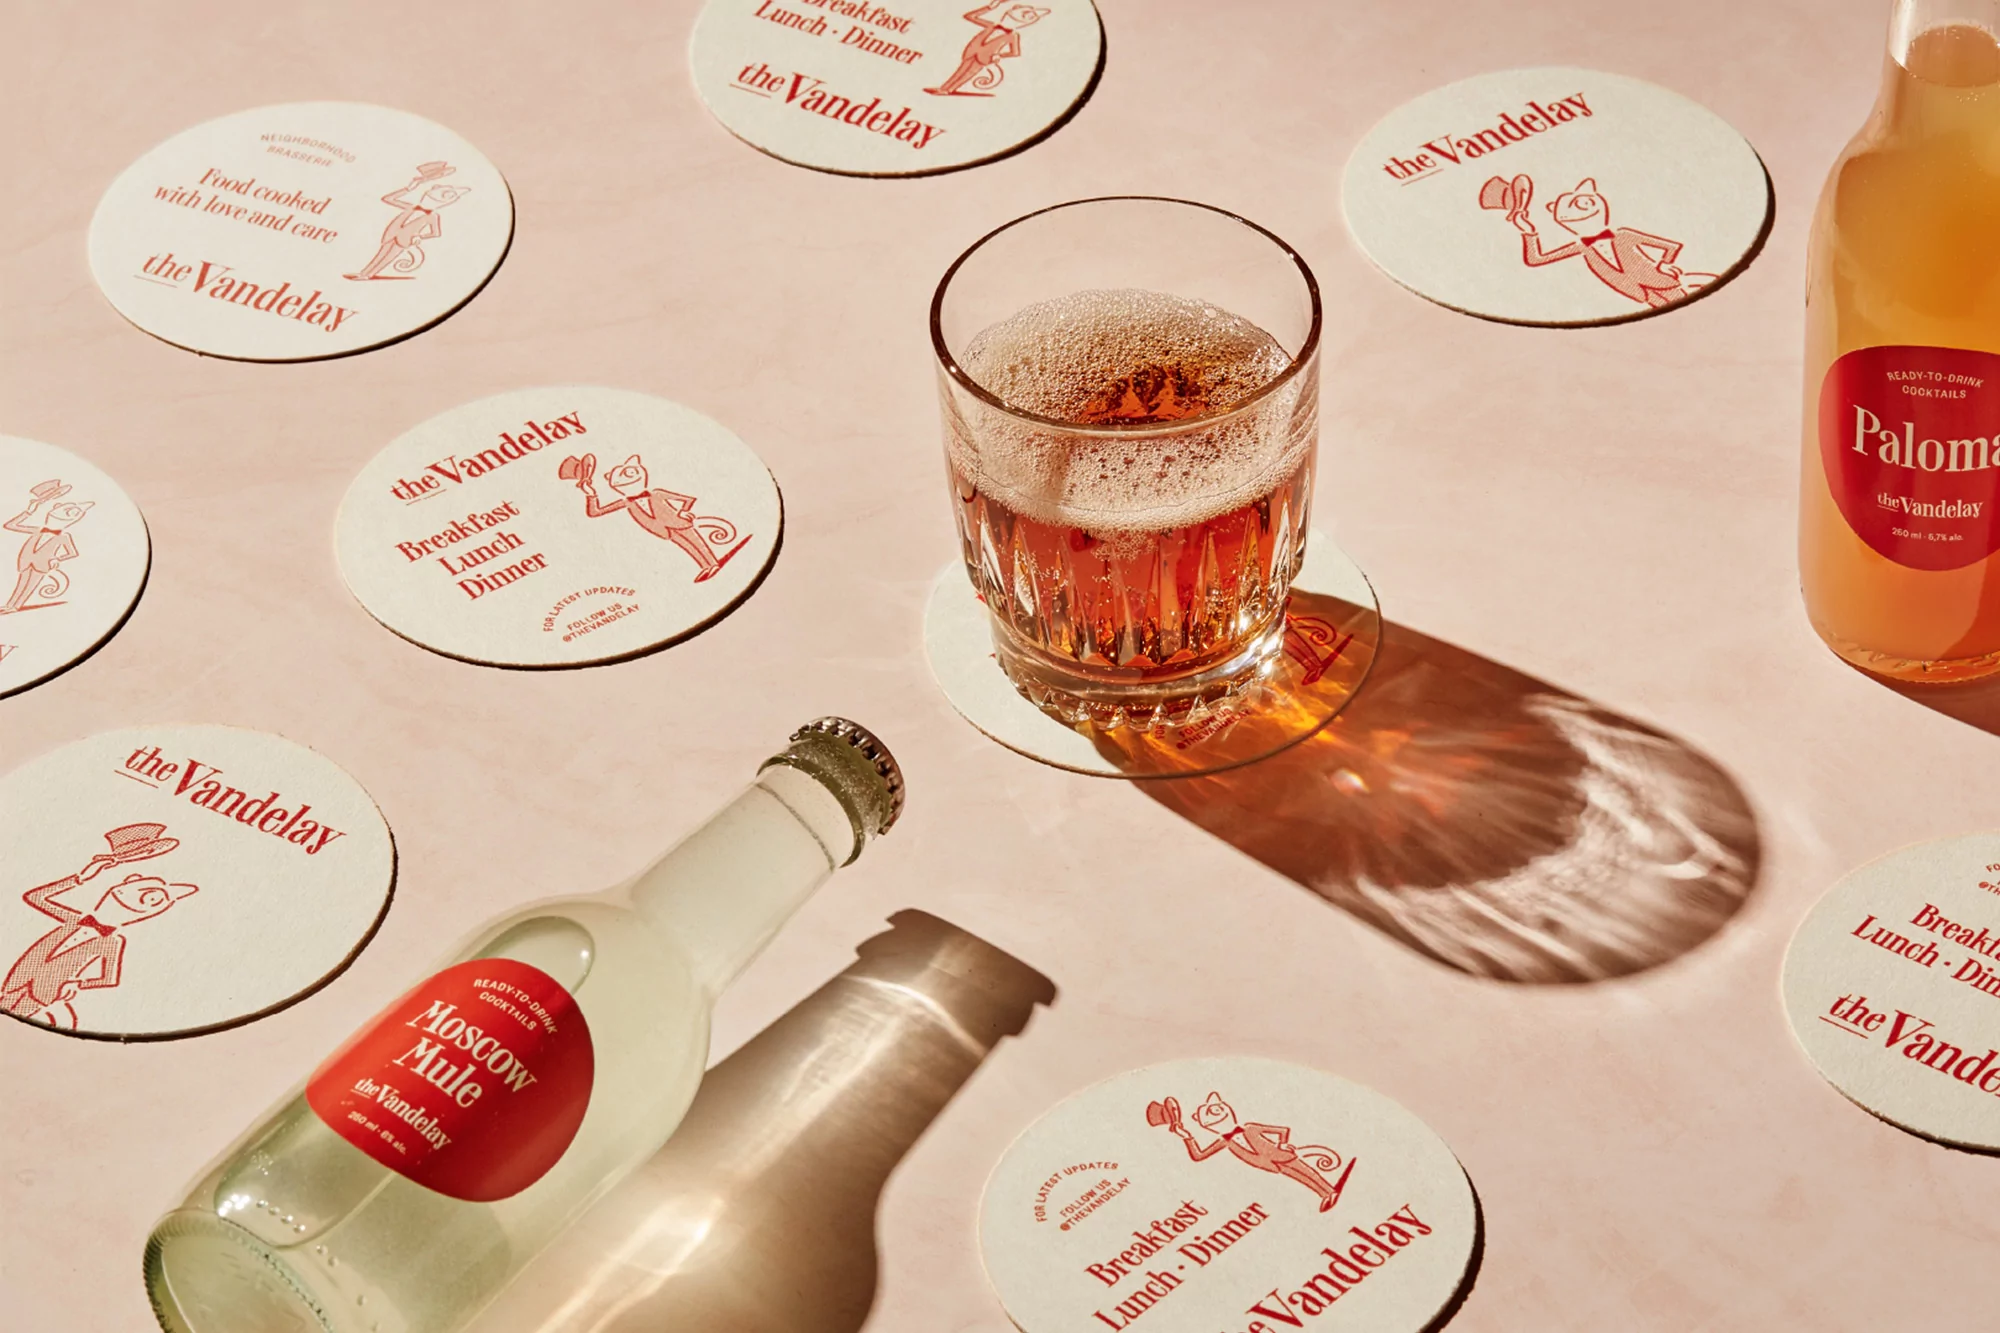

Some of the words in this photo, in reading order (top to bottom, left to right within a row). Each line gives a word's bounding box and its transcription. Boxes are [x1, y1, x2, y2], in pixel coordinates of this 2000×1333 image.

[753, 0, 828, 36] Lunch
[840, 25, 923, 65] Dinner
[260, 133, 356, 163] NEIGHBORHOOD
[267, 145, 334, 167] BRASSERIE
[199, 168, 255, 196] Food
[253, 185, 332, 215] cooked
[154, 184, 202, 209] with
[203, 195, 247, 220] love
[247, 206, 292, 230] and
[291, 222, 338, 243] care
[1887, 371, 1984, 388] READY-TO-DRINK
[1902, 385, 1967, 399] COCKTAILS
[394, 499, 520, 563] Breakfast
[437, 531, 525, 577] Lunch
[457, 549, 549, 601] Dinner
[548, 592, 581, 617] LATEST
[584, 586, 636, 597] UPDATES
[543, 617, 556, 632] FOR
[562, 604, 640, 642] @THEVANDELAY
[567, 610, 606, 631] FOLLOW
[607, 602, 623, 613] US
[1851, 914, 1940, 968] Lunch
[1909, 903, 2000, 962] Breakf
[473, 978, 558, 1034] READY-TO-DRINK
[479, 991, 537, 1031] COCKTAILS
[392, 1036, 483, 1108] Mule
[1884, 1009, 2000, 1099] Vande
[1036, 1172, 1062, 1203] LATEST
[1063, 1161, 1118, 1176] UPDATES
[1034, 1205, 1048, 1222] FOR
[1059, 1189, 1097, 1218] FOLLOW
[1095, 1179, 1112, 1191] US
[1060, 1177, 1131, 1231] @THEVANDELAY
[1084, 1199, 1209, 1288] Breakfast
[1092, 1265, 1184, 1333] Lunch
[1177, 1201, 1270, 1269] Dinner
